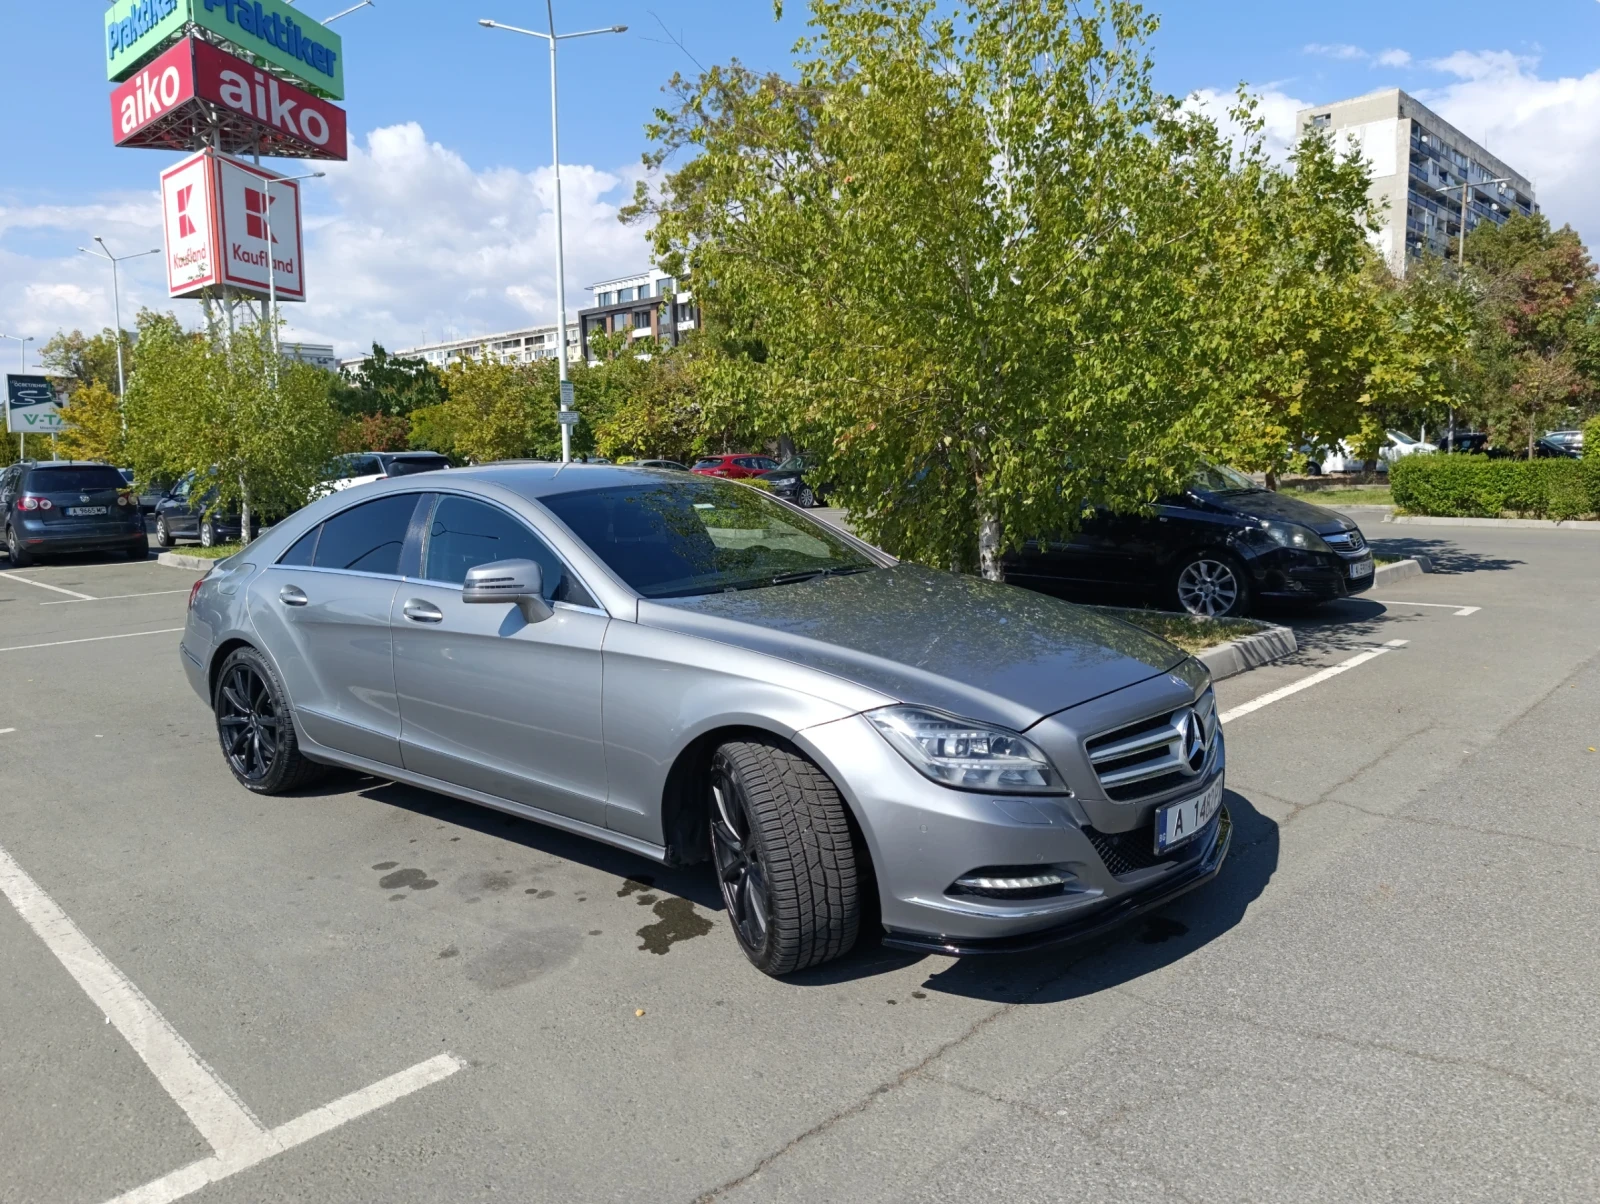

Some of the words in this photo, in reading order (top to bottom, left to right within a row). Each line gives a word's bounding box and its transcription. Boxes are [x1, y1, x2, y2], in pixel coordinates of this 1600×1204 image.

[121, 66, 180, 133] aiko
[219, 69, 330, 146] aiko
[233, 243, 293, 274] Kaufland
